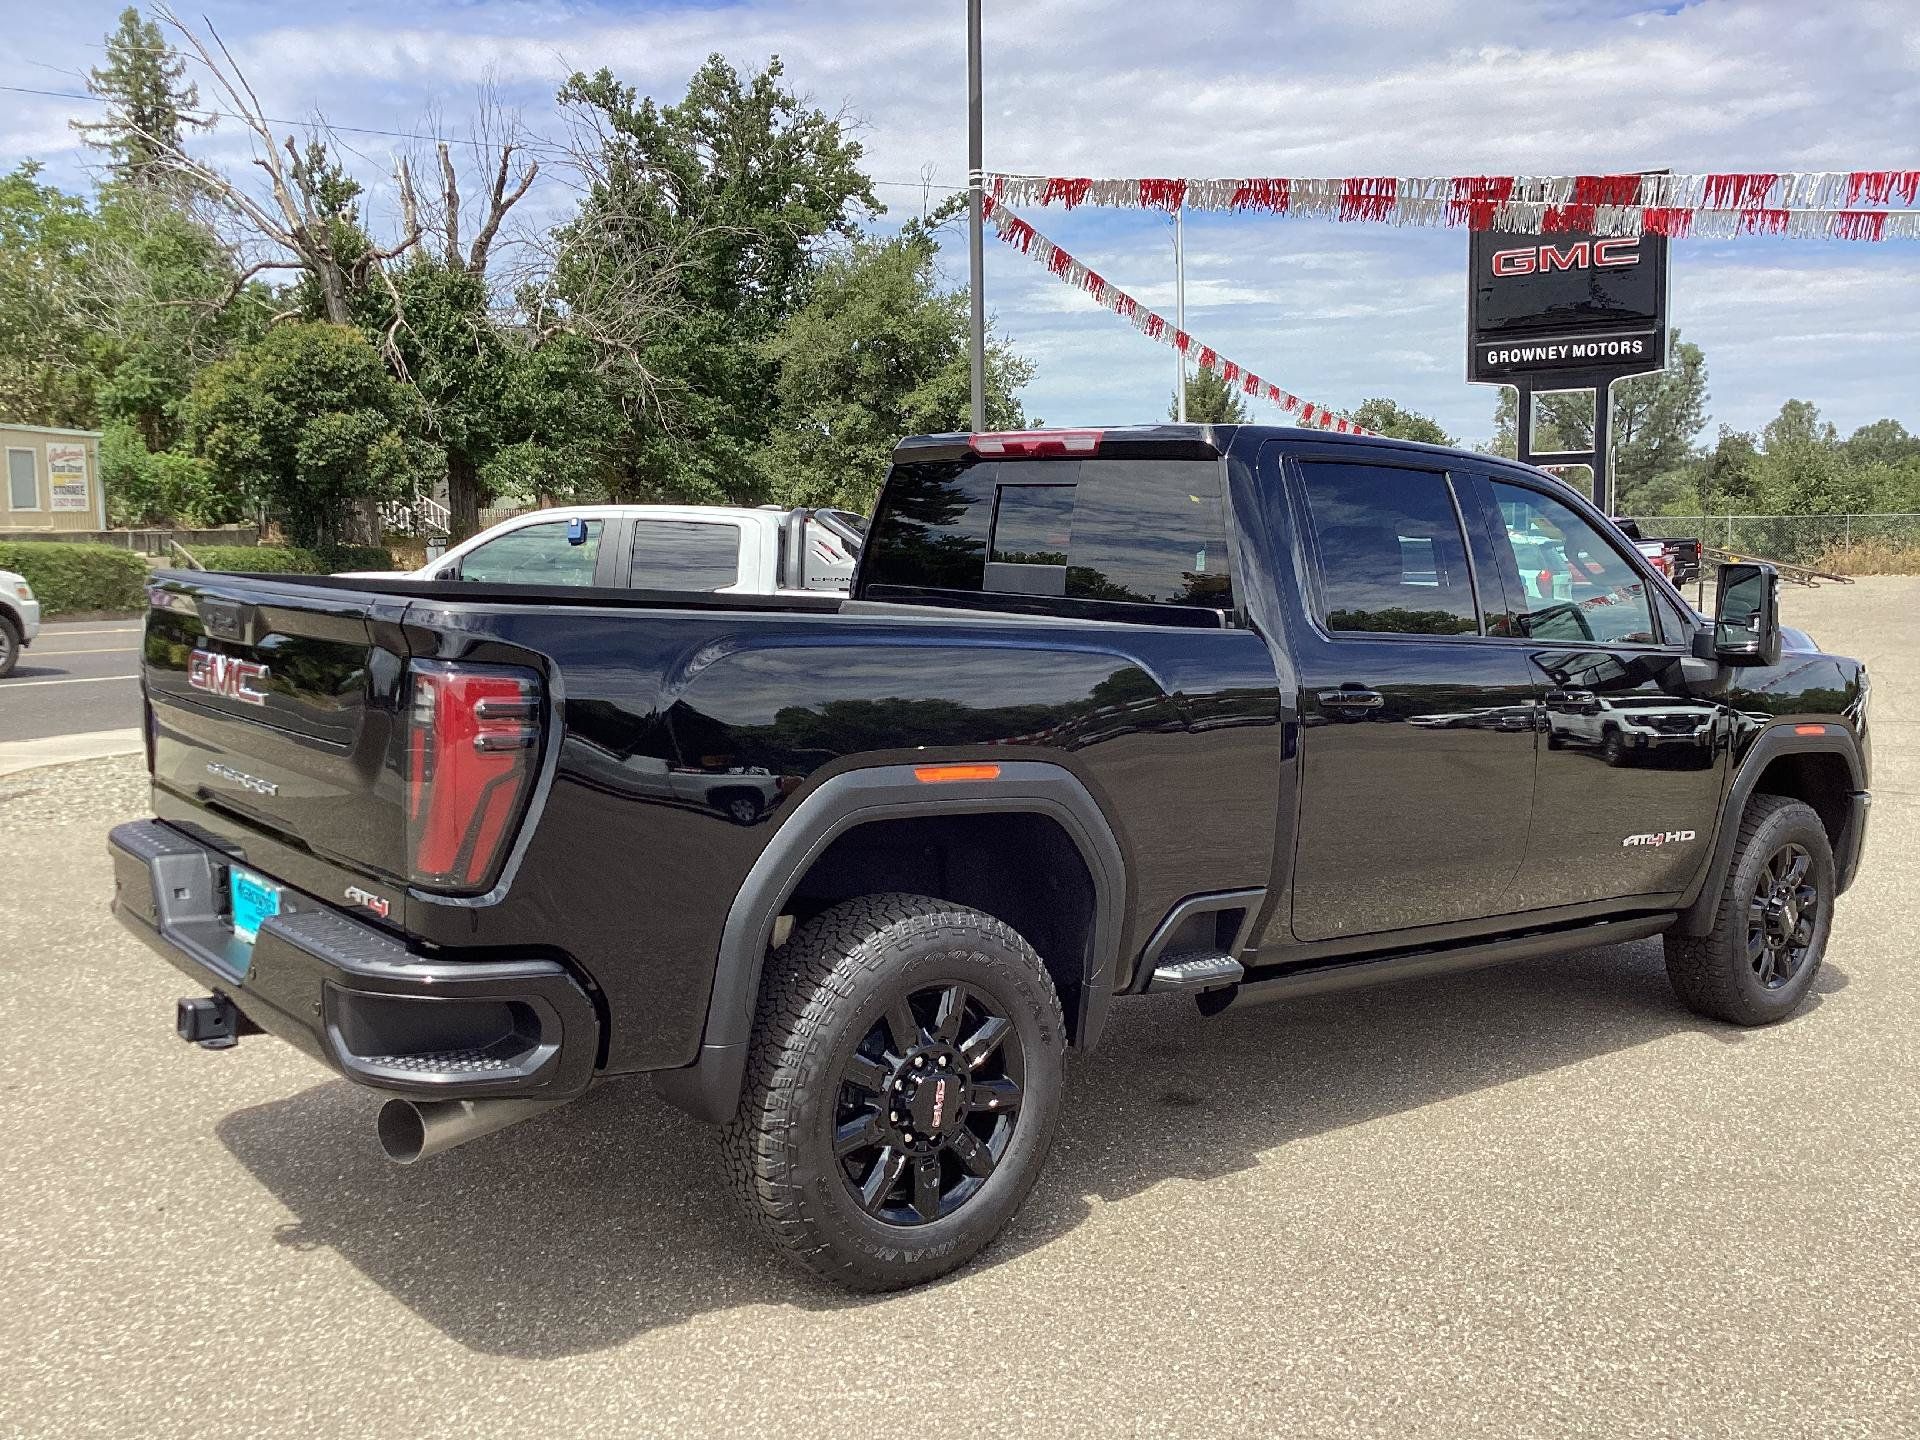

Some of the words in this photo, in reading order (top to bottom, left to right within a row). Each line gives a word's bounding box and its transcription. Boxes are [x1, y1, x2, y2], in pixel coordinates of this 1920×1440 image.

[1491, 236, 1640, 277] GMC
[1487, 345, 1568, 364] GROWNEY
[1572, 340, 1643, 358] MOTORS
[188, 649, 270, 706] GMC
[344, 886, 390, 918] AT4
[931, 1078, 945, 1127] GMC
